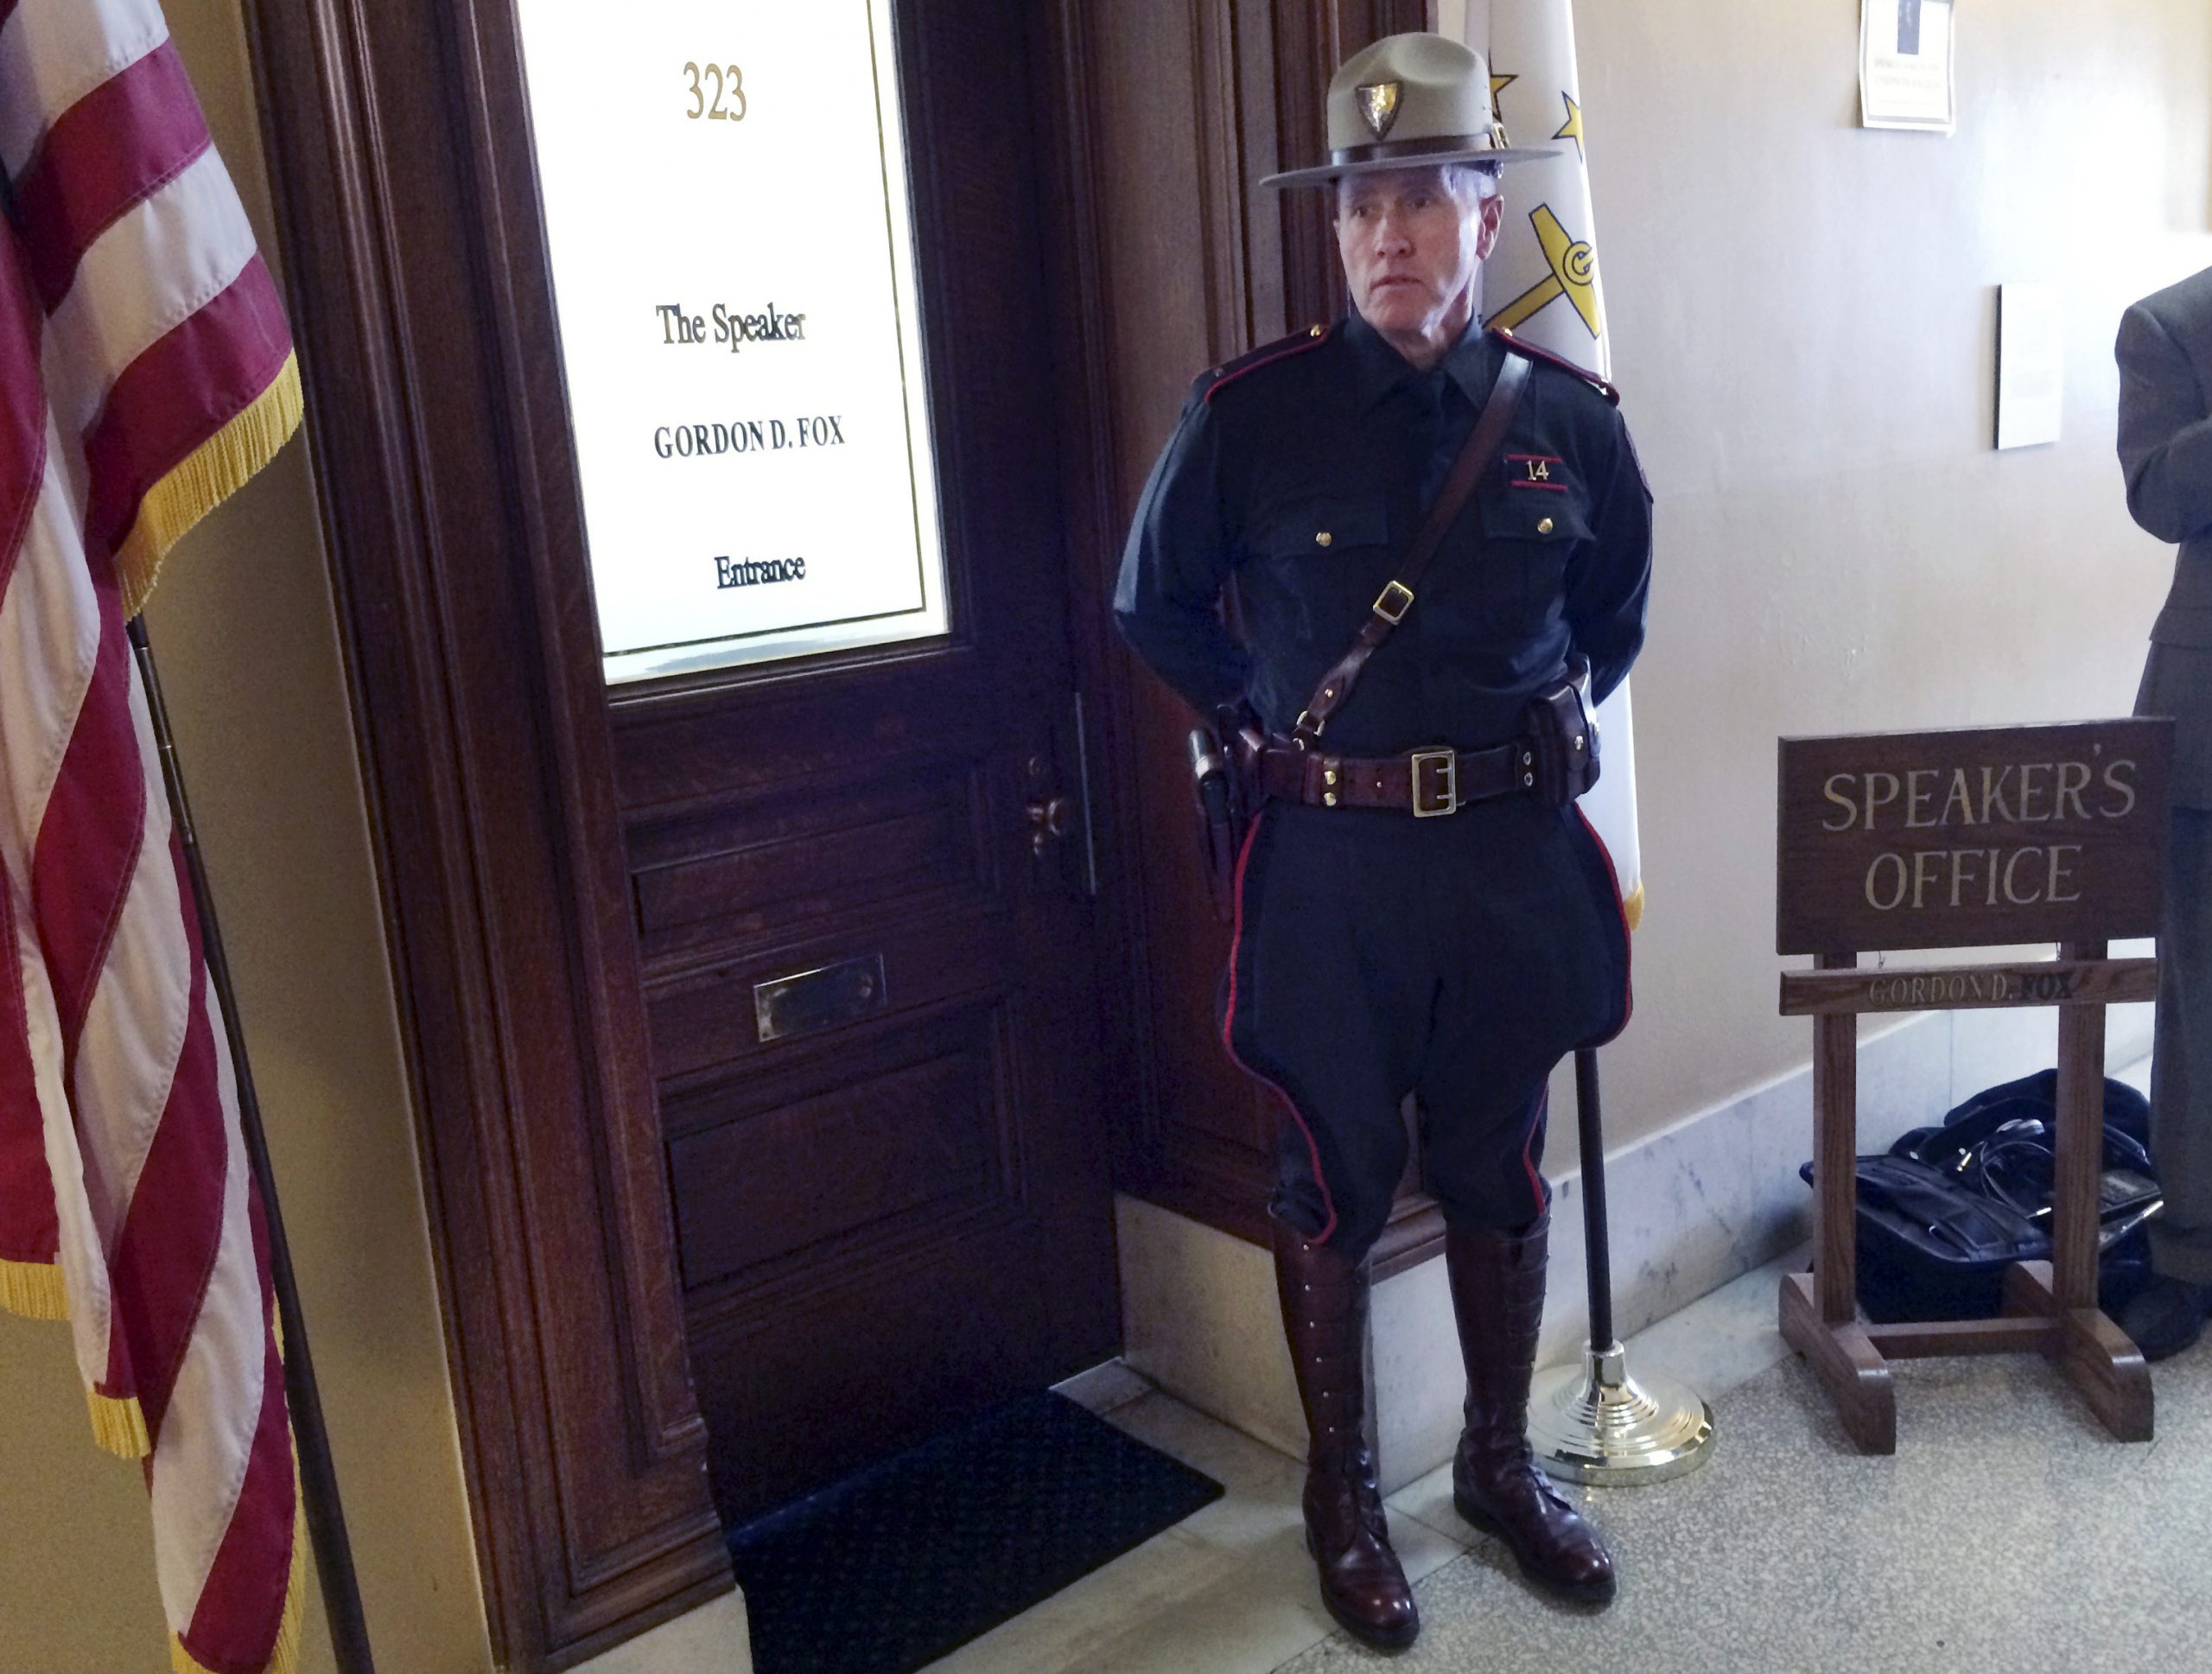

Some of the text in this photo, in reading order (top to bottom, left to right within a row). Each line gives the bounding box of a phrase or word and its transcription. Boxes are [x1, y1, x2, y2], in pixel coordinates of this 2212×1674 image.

[683, 61, 747, 121] 323
[656, 302, 806, 353] The Speaker
[654, 416, 845, 459] GORDON D. FOX
[1526, 460, 1549, 481] 14
[714, 556, 806, 589] Entrance
[1821, 743, 2136, 831] SPEAKER'S
[1865, 845, 2082, 910] OFFICE
[1868, 971, 2073, 1007] GORDON D. FOX
